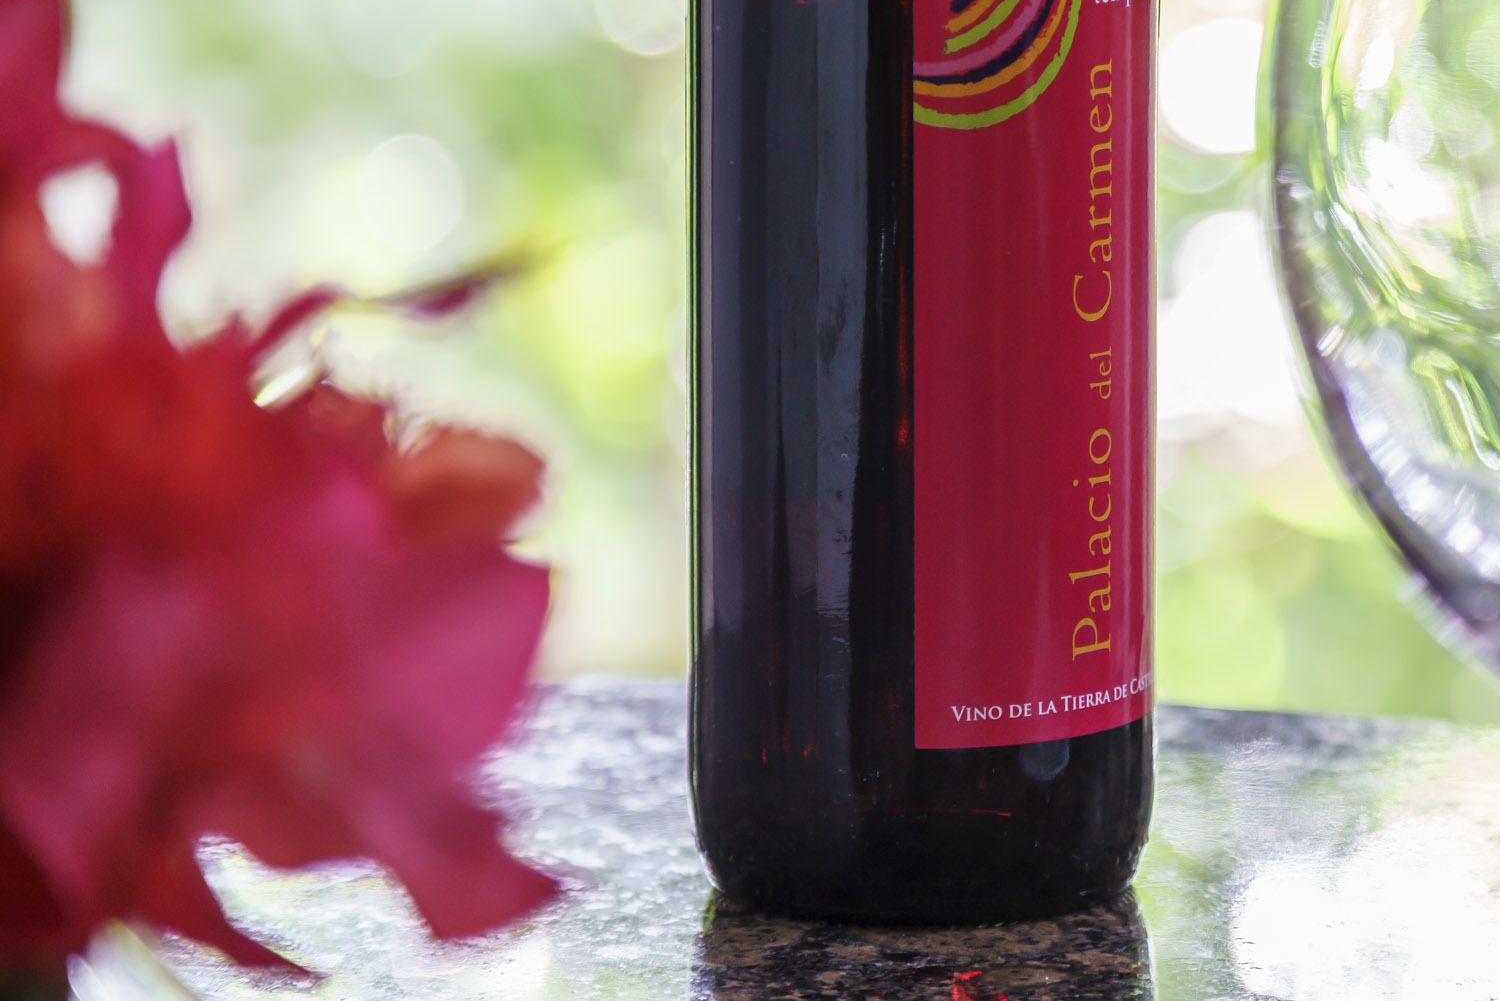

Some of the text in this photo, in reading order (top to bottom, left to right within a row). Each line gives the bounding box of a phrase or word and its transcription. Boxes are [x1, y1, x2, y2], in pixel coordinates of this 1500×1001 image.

[1068, 58, 1112, 661] Palacio del Carmen
[951, 705, 1003, 722] VINO
[1008, 703, 1032, 719] DE
[1038, 701, 1057, 716] LA
[1061, 690, 1111, 712] TIERRA
[1113, 684, 1128, 701] DE
